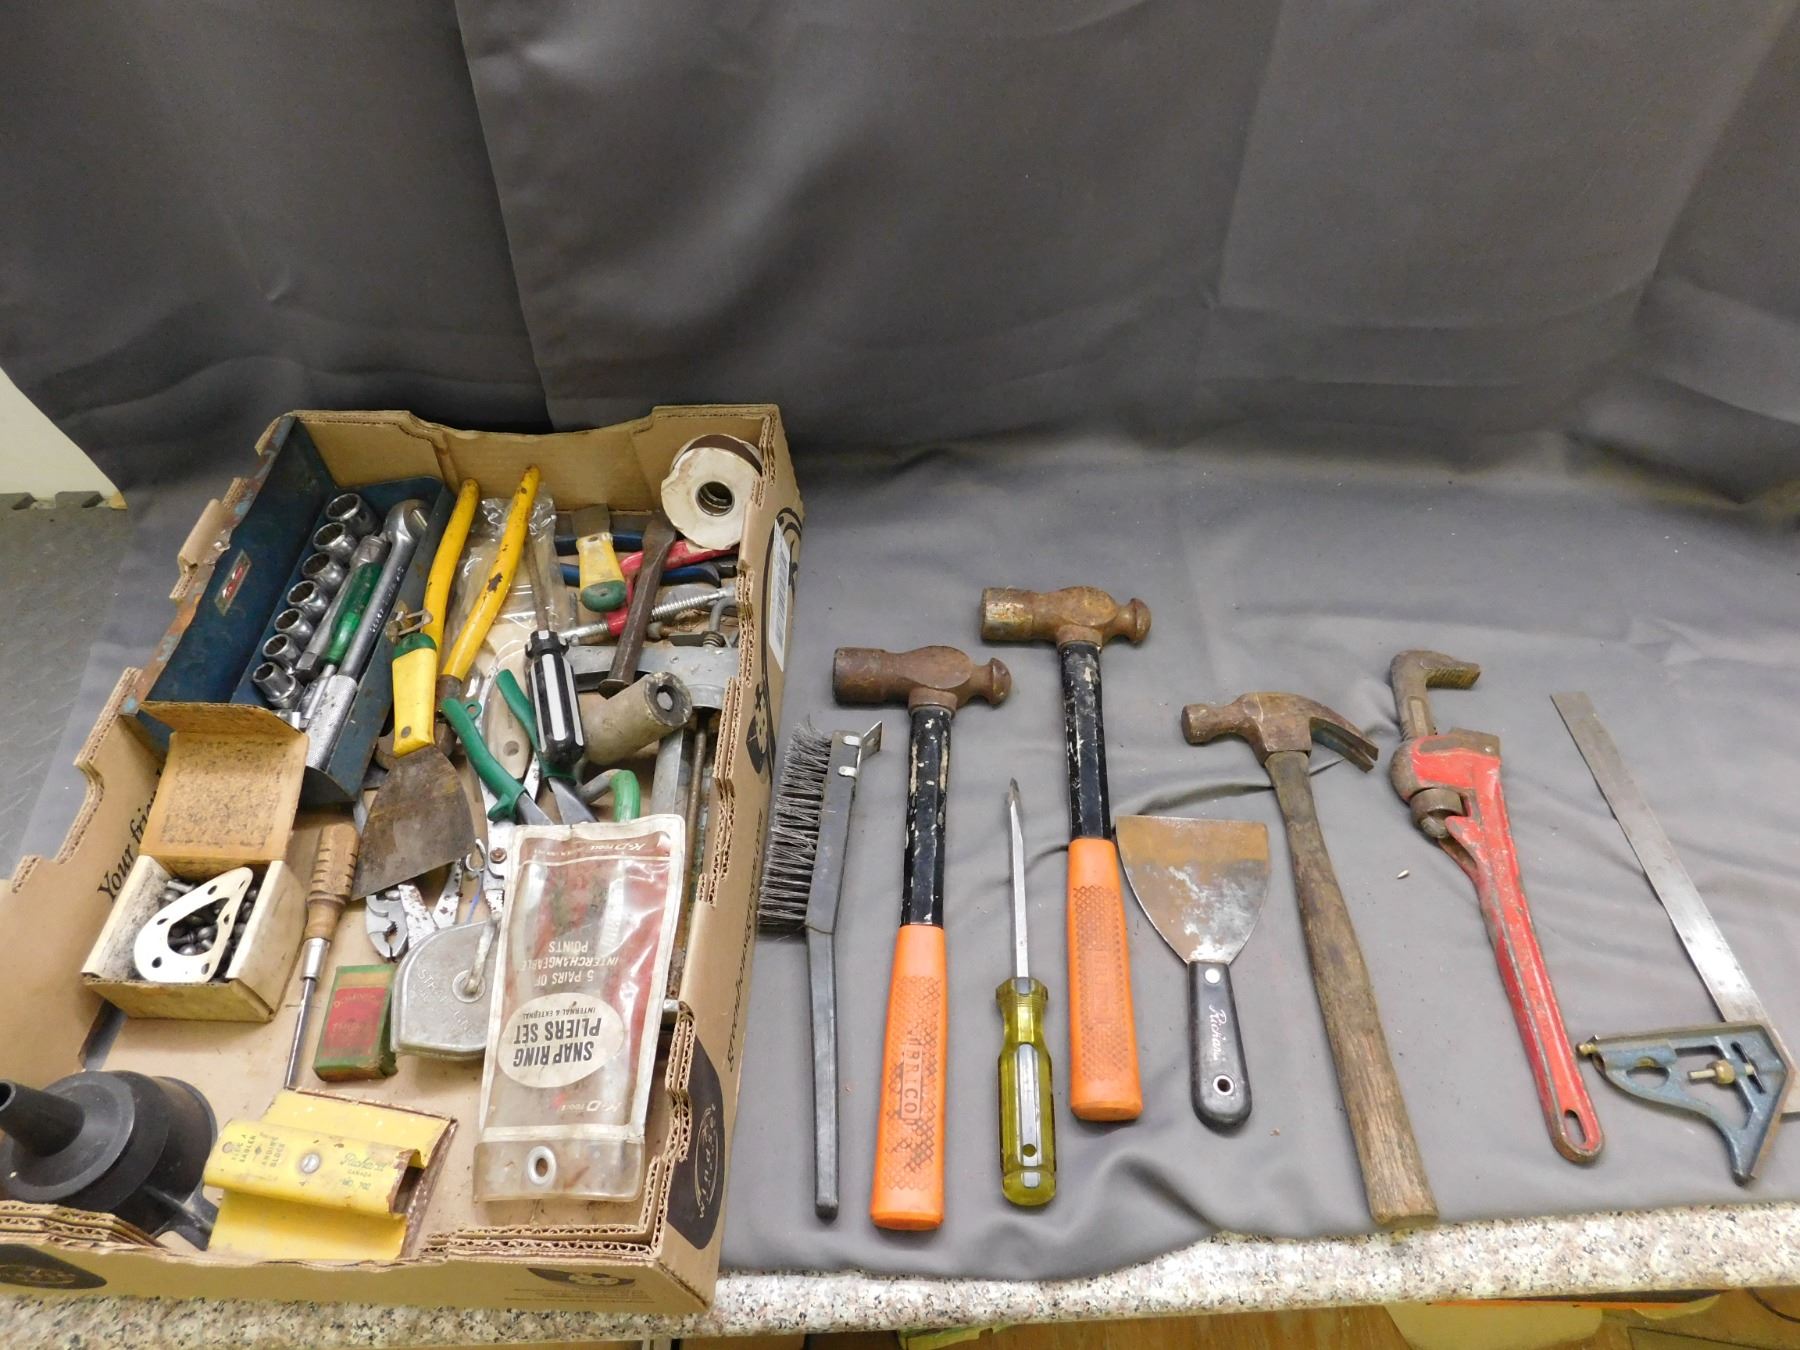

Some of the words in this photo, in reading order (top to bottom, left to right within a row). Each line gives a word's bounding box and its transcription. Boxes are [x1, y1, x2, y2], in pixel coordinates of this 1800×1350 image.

[97, 844, 134, 901] Your
[548, 940, 589, 953] POINTS
[520, 956, 619, 971] INTERCHANGEABLE
[551, 970, 582, 985] PAIRS
[586, 970, 594, 982] 5
[562, 1007, 596, 1015] INTERNAL
[514, 1023, 538, 1044] SET
[544, 1018, 602, 1041] PLIERS
[513, 1045, 551, 1067] RING
[553, 1041, 594, 1064] SNAP
[903, 1049, 920, 1114] BRICO
